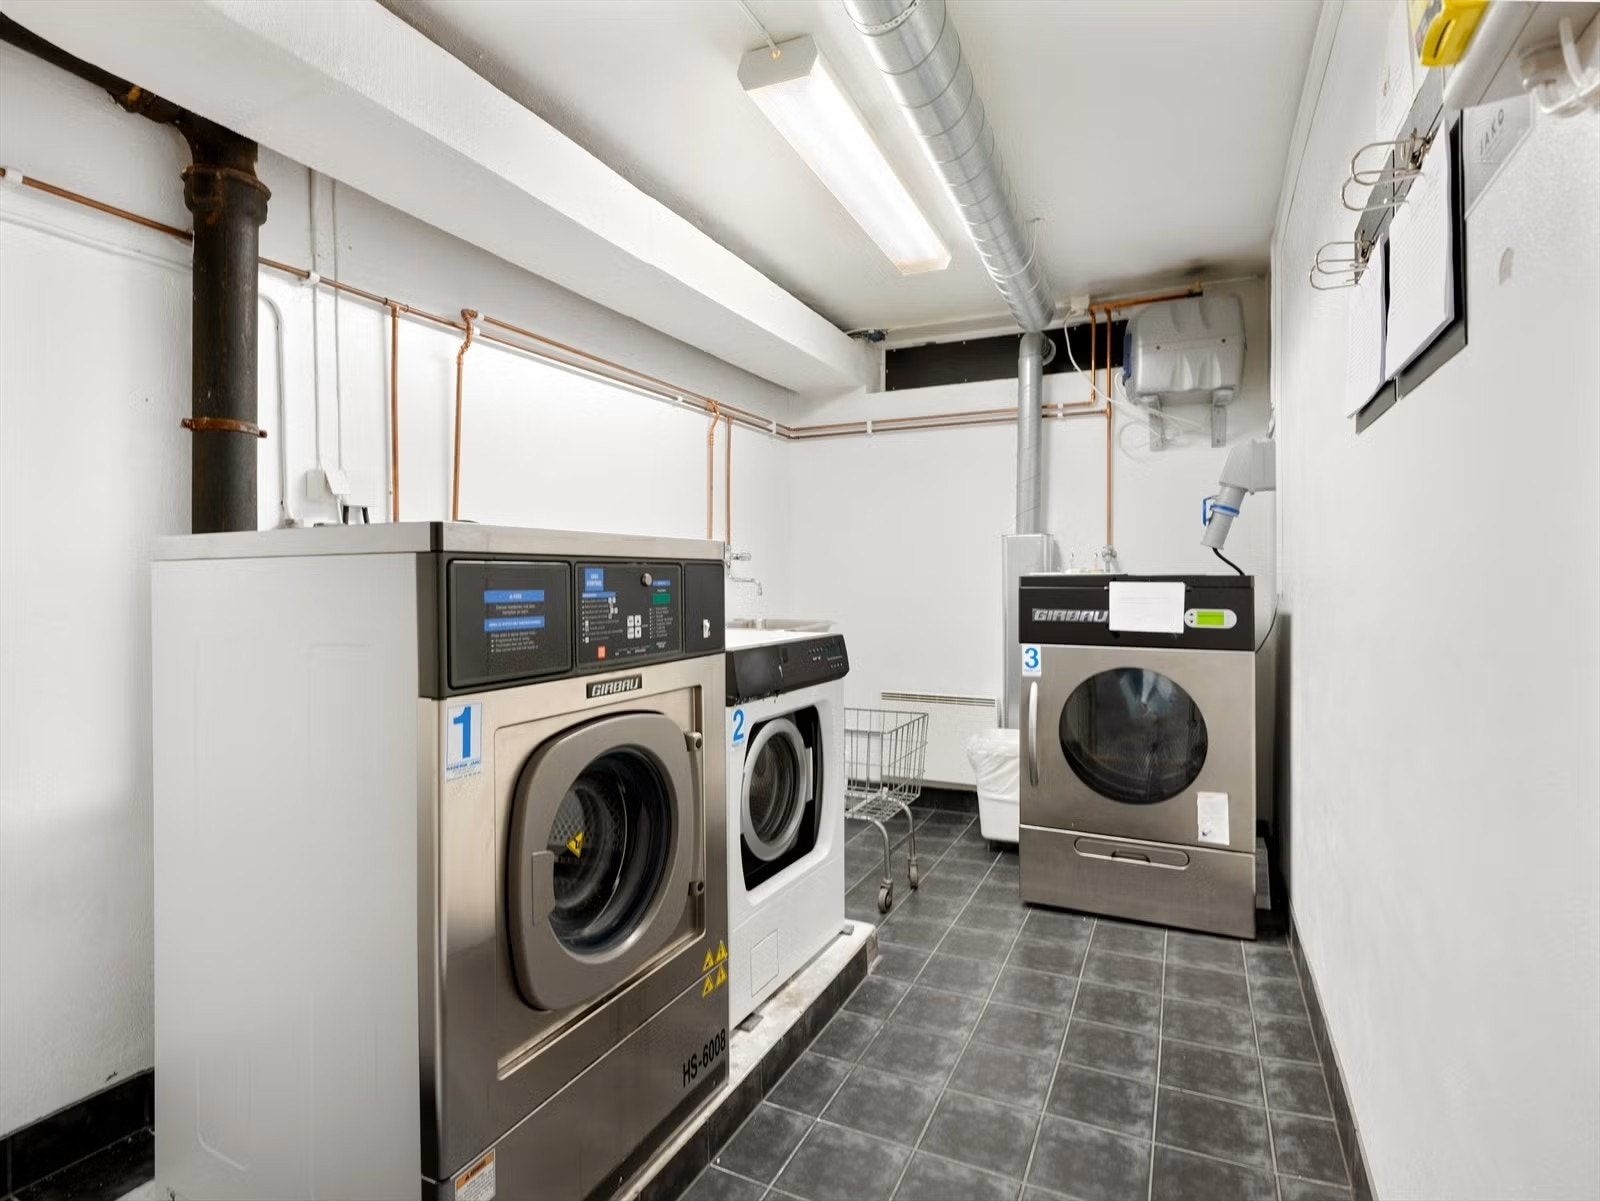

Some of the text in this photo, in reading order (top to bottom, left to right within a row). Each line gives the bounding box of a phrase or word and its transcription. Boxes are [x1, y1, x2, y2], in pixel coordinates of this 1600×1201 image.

[1033, 608, 1109, 622] GIRBAU
[1024, 647, 1039, 669] 3
[591, 678, 639, 697] GIRBAU
[453, 705, 471, 759] 1
[733, 709, 744, 741] 2
[682, 1028, 726, 1088] HS-6008
